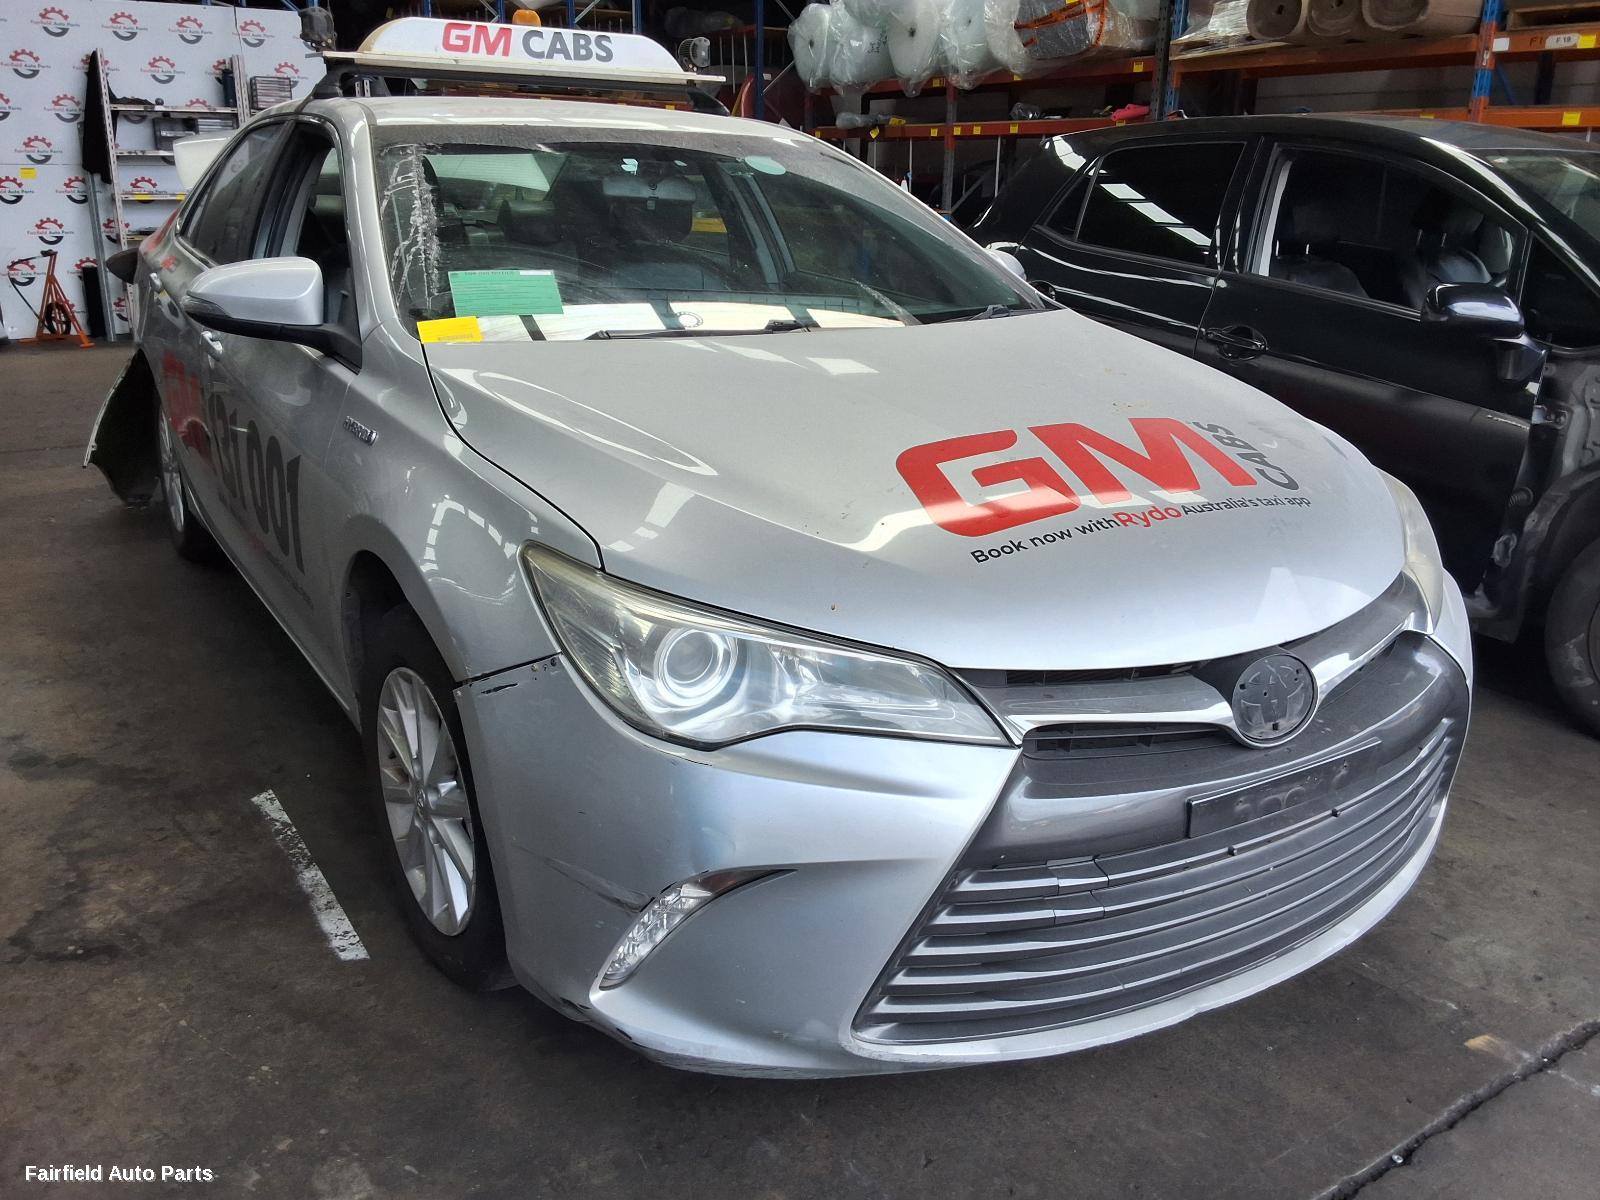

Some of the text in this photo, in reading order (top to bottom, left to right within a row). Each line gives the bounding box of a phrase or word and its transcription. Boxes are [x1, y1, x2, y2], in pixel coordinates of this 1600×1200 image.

[442, 22, 614, 63] GM CABS
[896, 417, 1258, 538] GM
[1191, 421, 1300, 491] CABS
[970, 495, 1311, 564] Book now with Rydo Australia's taxi app
